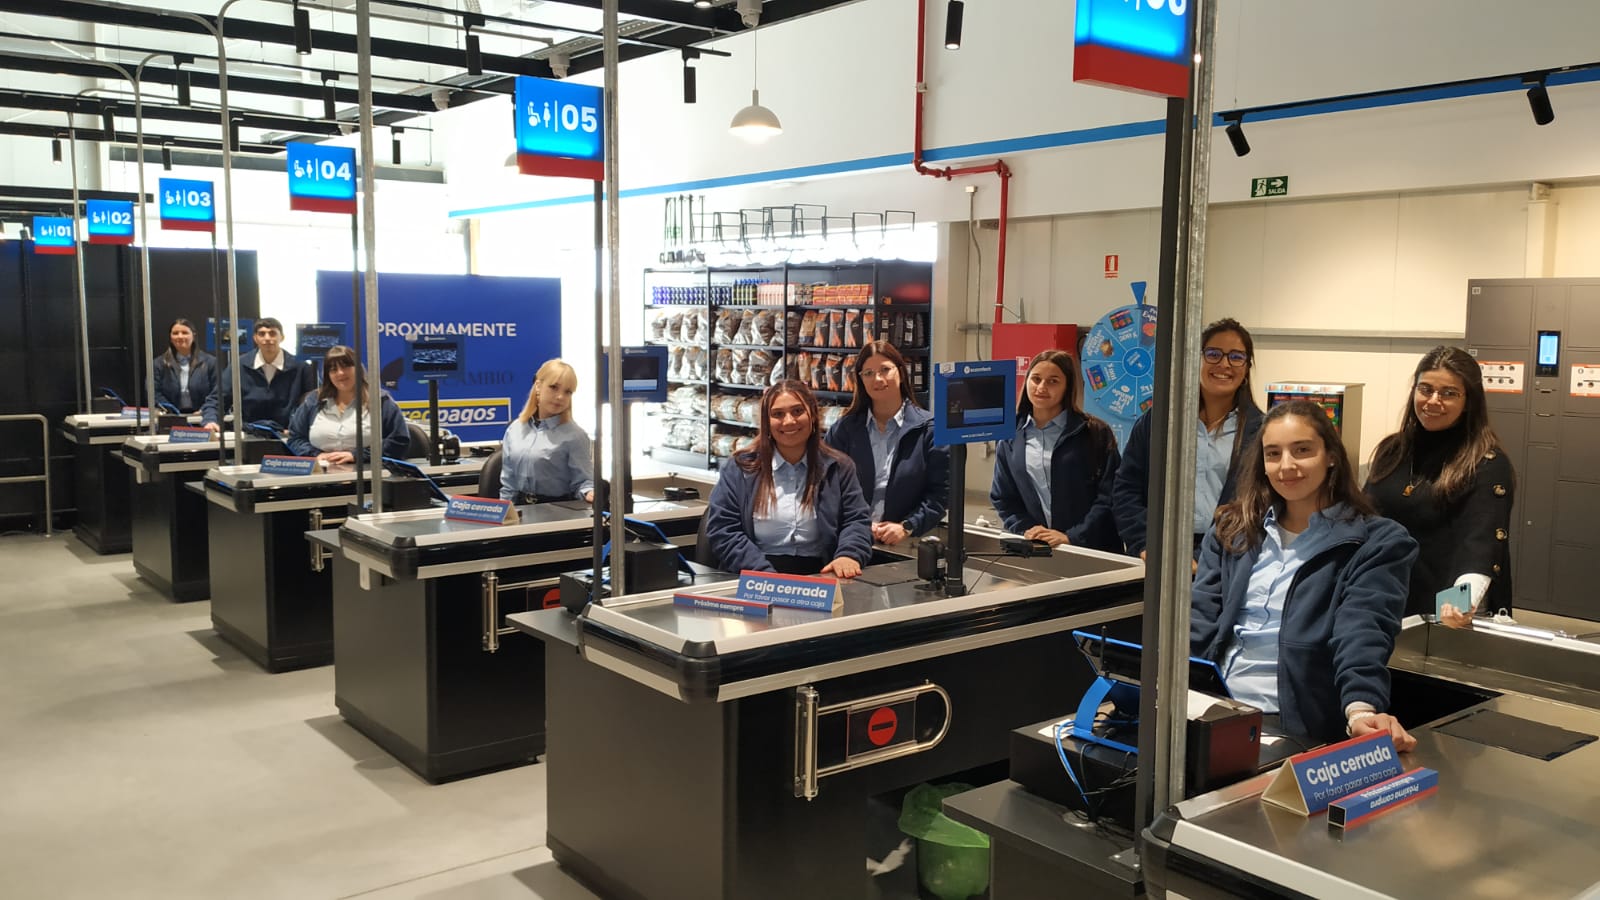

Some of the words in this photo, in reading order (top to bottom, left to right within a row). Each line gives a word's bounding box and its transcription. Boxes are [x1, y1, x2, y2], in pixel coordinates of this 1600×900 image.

[561, 104, 598, 133] 05
[321, 160, 352, 181] 04
[187, 190, 211, 207] 03
[111, 211, 131, 225] 02
[57, 225, 72, 237] 01
[451, 501, 471, 511] Caja
[745, 579, 775, 595] Caja
[777, 584, 827, 599] cerrada
[810, 600, 825, 609] caja
[1306, 760, 1341, 786] Caja
[1341, 745, 1392, 774] cerrada
[1314, 790, 1326, 801] Por
[1326, 785, 1344, 797] favor
[1344, 778, 1363, 793] pasar
[1363, 776, 1370, 784] a
[1369, 770, 1383, 782] otra
[1383, 766, 1398, 778] caja
[1370, 793, 1395, 809] compra
